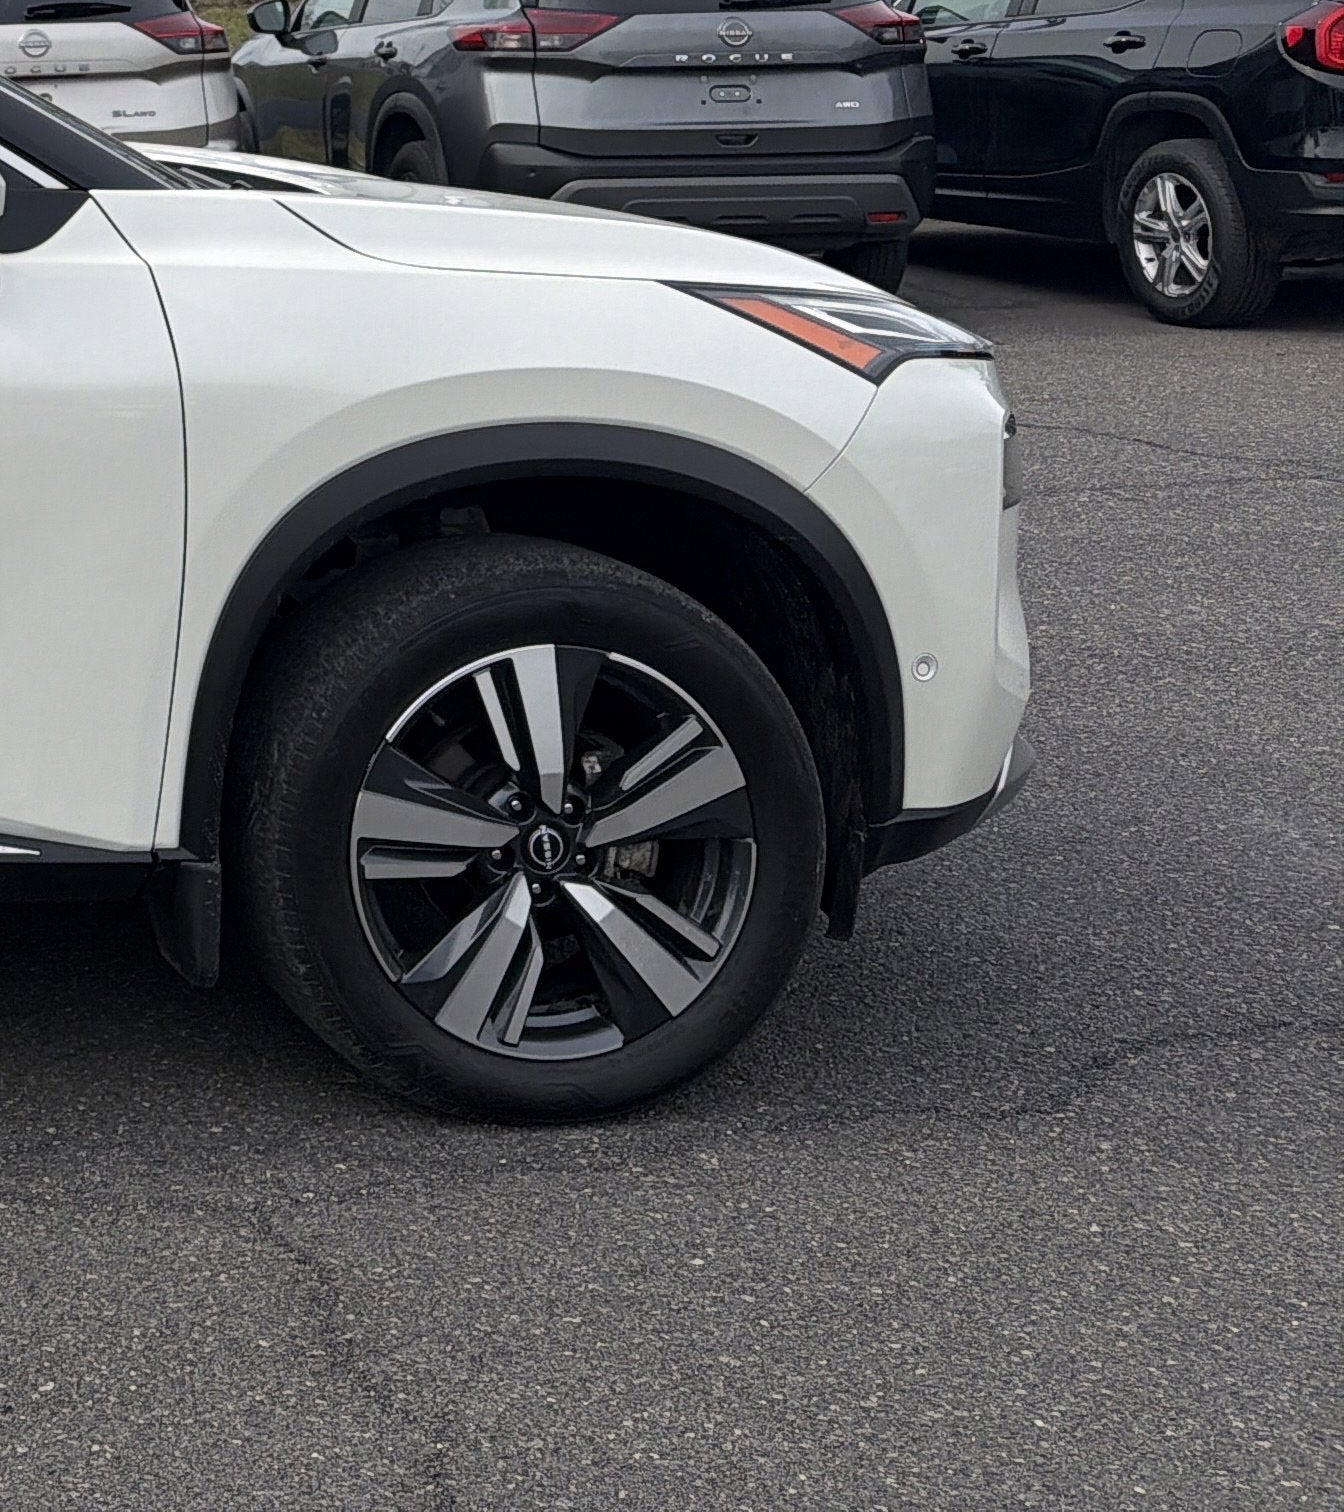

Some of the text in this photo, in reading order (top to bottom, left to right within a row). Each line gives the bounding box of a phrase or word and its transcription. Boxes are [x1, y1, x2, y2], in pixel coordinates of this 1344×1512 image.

[675, 52, 794, 63] ROGUE
[4, 63, 91, 75] OGUE
[834, 100, 860, 109] AWD
